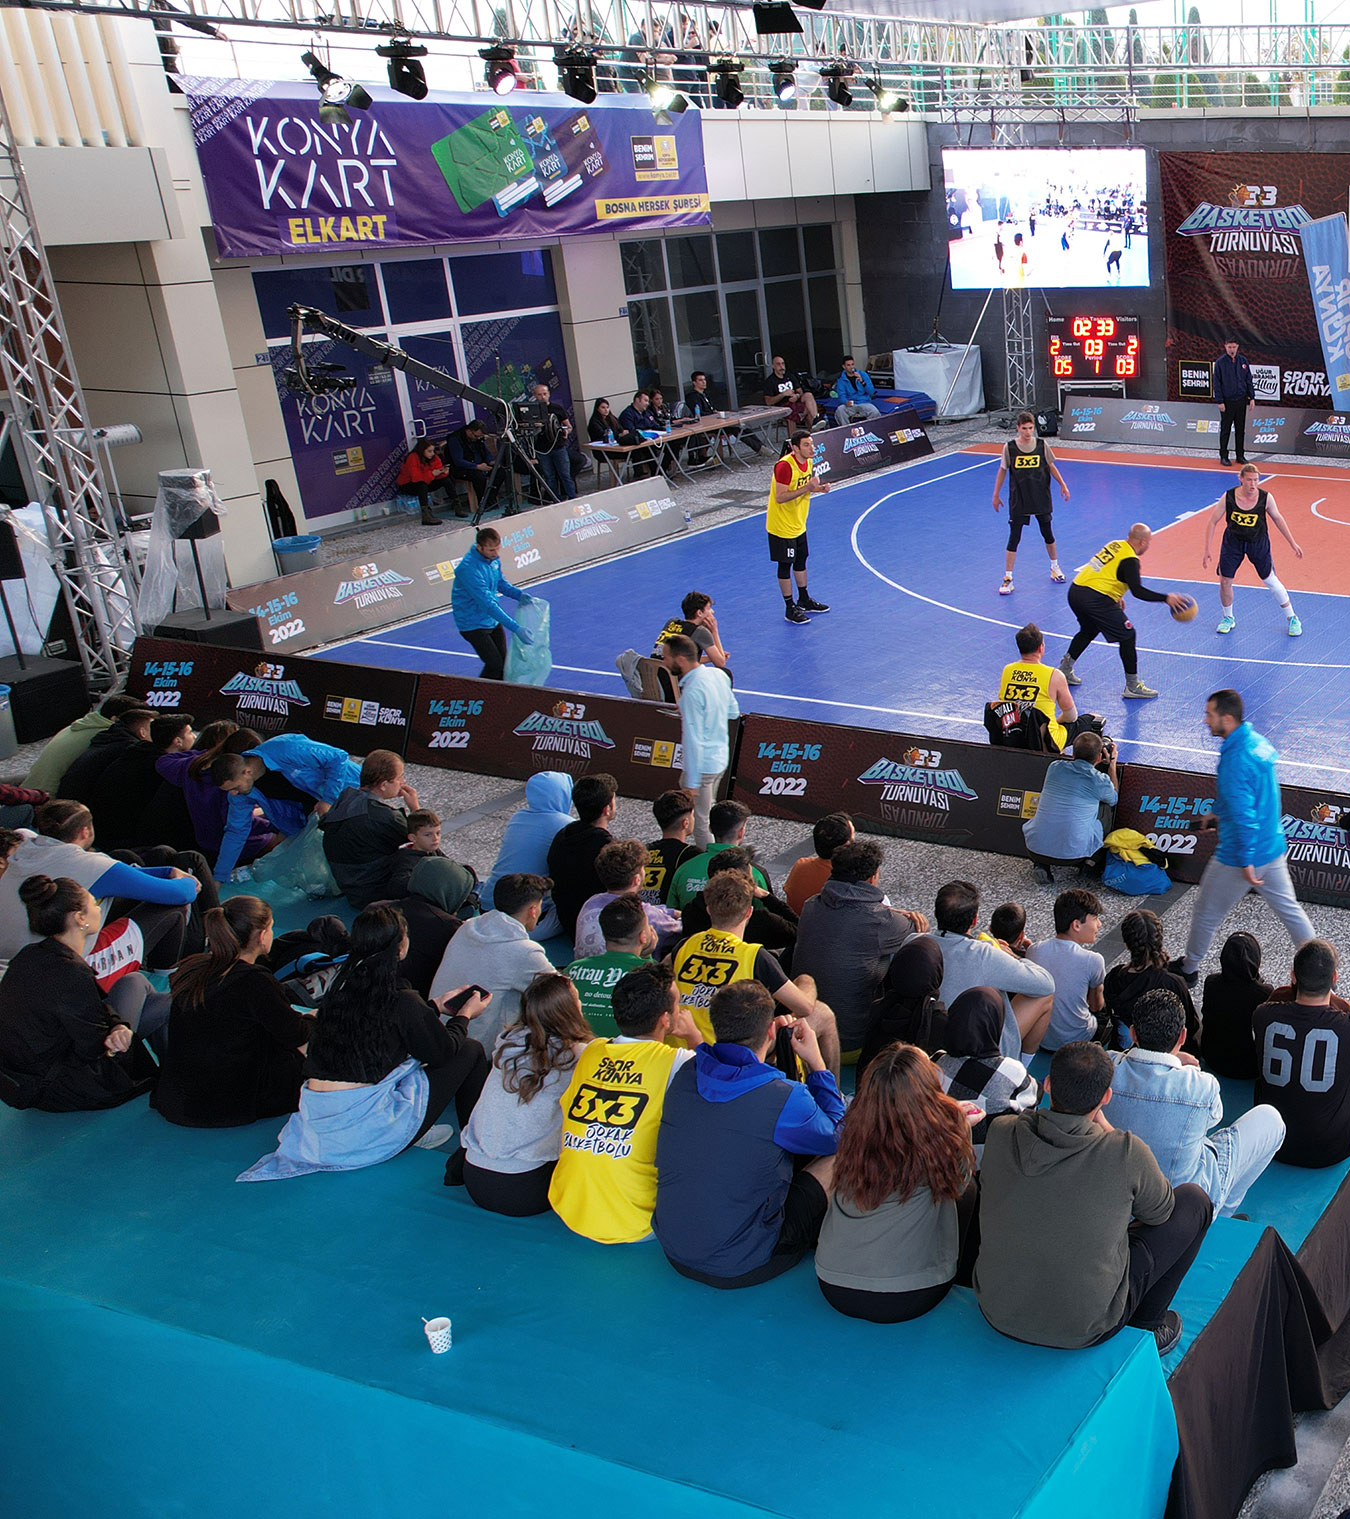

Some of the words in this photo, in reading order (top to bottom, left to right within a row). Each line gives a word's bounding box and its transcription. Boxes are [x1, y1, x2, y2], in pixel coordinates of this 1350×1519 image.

[246, 116, 396, 156] KONYA
[255, 159, 397, 210] KART
[605, 202, 637, 215] BOSNA
[638, 200, 670, 212] HERSEK
[673, 195, 702, 212] ŞUBESİ
[288, 215, 387, 244] ELKART
[1210, 232, 1299, 256] TURNUVASI
[1050, 339, 1060, 355] 2
[1084, 339, 1103, 355] 03
[1127, 339, 1138, 355] 2
[1054, 359, 1072, 375] 05
[1095, 360, 1100, 374] 1
[1116, 359, 1135, 375] 03
[1182, 369, 1209, 380] BENİM
[1255, 367, 1272, 375] UĞUR
[1182, 378, 1209, 389] ŞEHRİM
[1283, 371, 1326, 384] SPOR
[301, 406, 376, 445] KART
[1072, 423, 1096, 432] 2022
[1120, 411, 1177, 426] BASKETBOL
[1253, 434, 1279, 443] 2022
[1315, 433, 1350, 444] TURNUVASI
[813, 461, 831, 477] 2022
[1016, 455, 1040, 468] 3x3
[560, 508, 620, 538] BASKETBOL
[1232, 513, 1258, 526] 3x3
[575, 523, 612, 542] TURNUVASI
[514, 549, 541, 569] 2022
[333, 569, 414, 604] BASKETBOL
[354, 586, 403, 609] TURNUVASI
[268, 610, 292, 626] Ekim
[268, 619, 306, 644] 2022
[144, 661, 194, 676] 14-15-16
[1012, 670, 1034, 678] SPOR
[153, 677, 178, 688] Ekim
[1011, 674, 1038, 683] KONYA
[219, 671, 311, 707] BASKETBOL
[1005, 685, 1037, 701] 3x3
[145, 691, 182, 707] 2022
[236, 695, 290, 716] TURNUVASI
[428, 700, 484, 716] 14-15-16
[378, 714, 406, 727] KONYA
[379, 707, 402, 717] SPOR
[439, 717, 466, 728] Ekim
[512, 711, 616, 749] BASKETBOL
[428, 731, 470, 749] 2022
[532, 735, 591, 759] TURNUVASI
[758, 742, 822, 761] 14-15-16
[770, 760, 802, 773] Ekim
[759, 776, 808, 797] 2022
[857, 757, 979, 801] BASKETBOL
[880, 785, 951, 811] TURNUVASI
[1139, 795, 1215, 816] 14-15-16
[1154, 815, 1191, 829] Ekim
[1145, 832, 1198, 855] 2022
[569, 965, 605, 985] Stray
[680, 958, 732, 986] 3x3
[598, 1056, 635, 1072] SPOR
[1262, 1021, 1339, 1093] 60
[592, 1068, 643, 1085] KONYA
[571, 1088, 641, 1126] 3x3
[586, 1122, 634, 1142] SOKAK
[564, 1131, 633, 1160] BASKETBOLU
